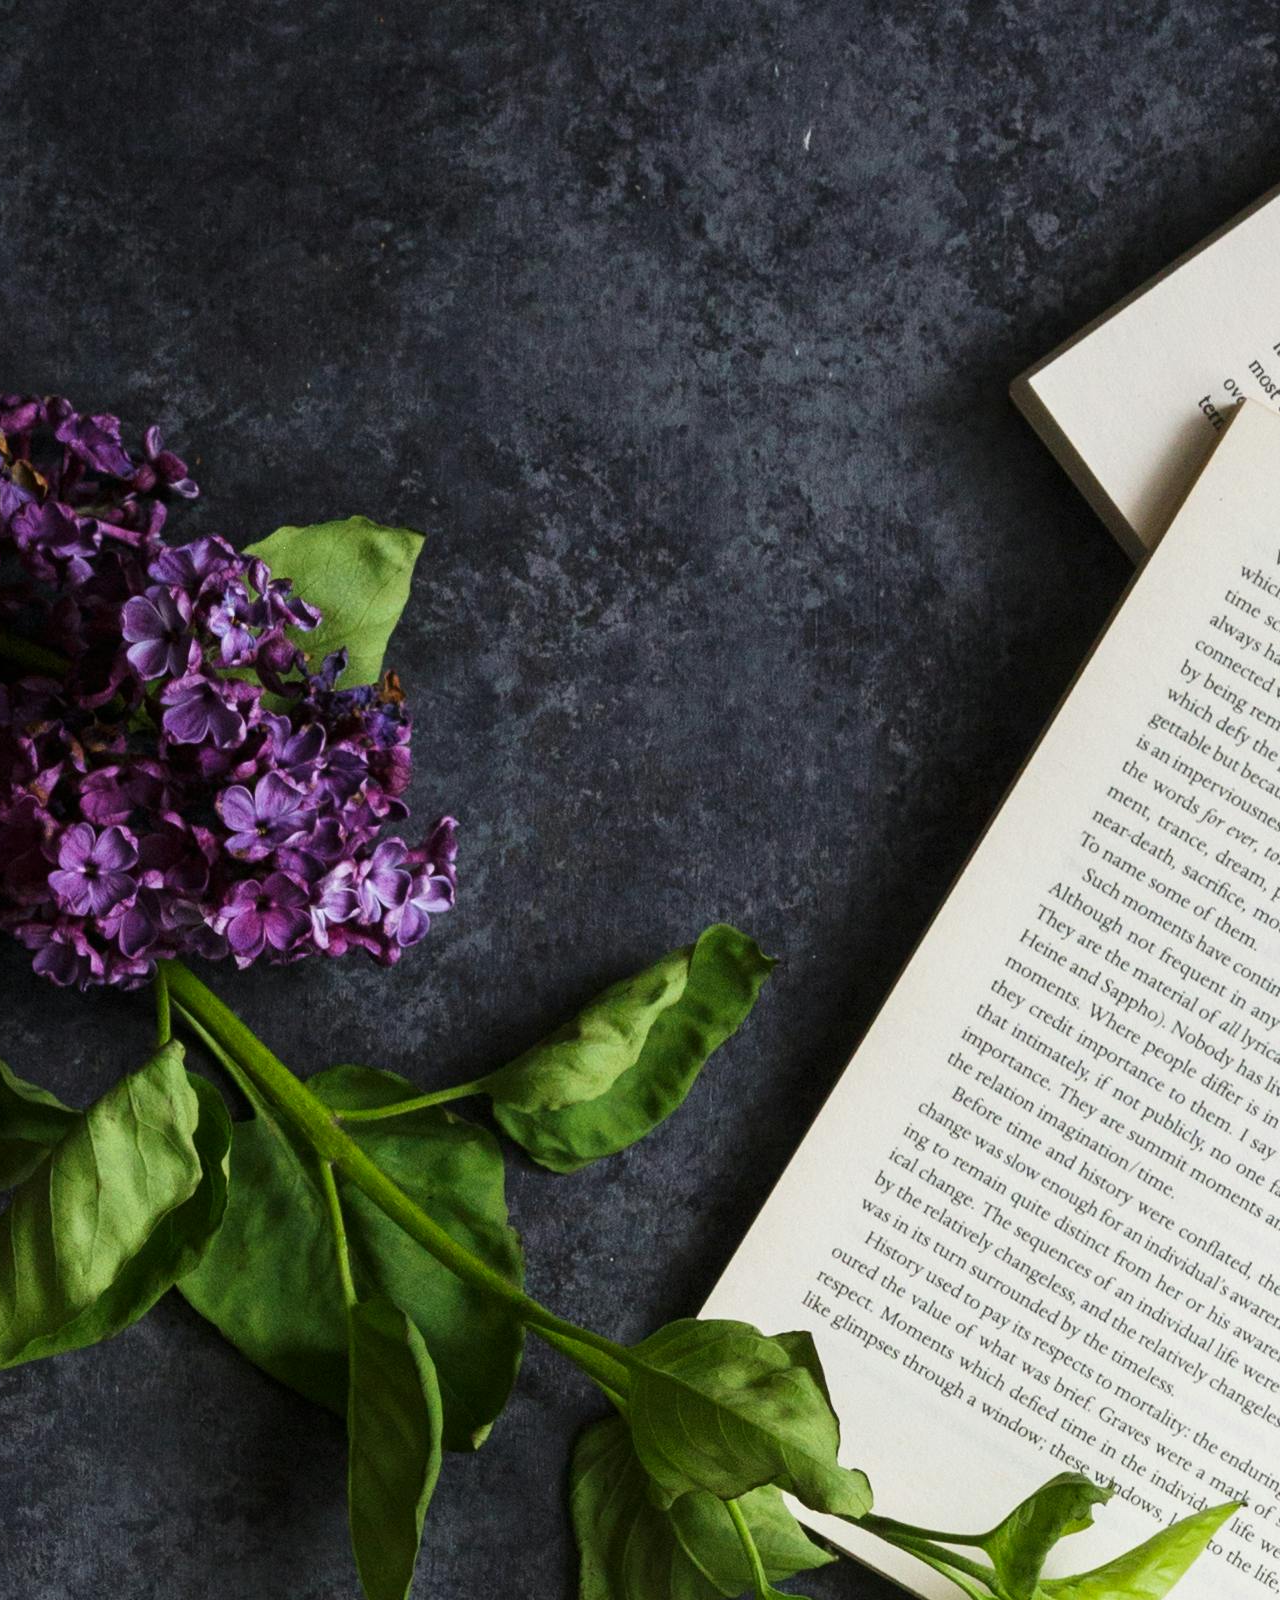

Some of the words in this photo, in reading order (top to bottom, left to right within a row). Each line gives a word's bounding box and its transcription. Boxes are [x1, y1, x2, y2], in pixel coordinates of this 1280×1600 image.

[1080, 829, 1100, 854] To
[1100, 848, 1147, 882] name
[1147, 877, 1191, 909] some
[1192, 904, 1217, 921] of
[1213, 914, 1257, 952] them.
[1091, 809, 1176, 871] near-death,
[1180, 864, 1246, 913] sacrifice,
